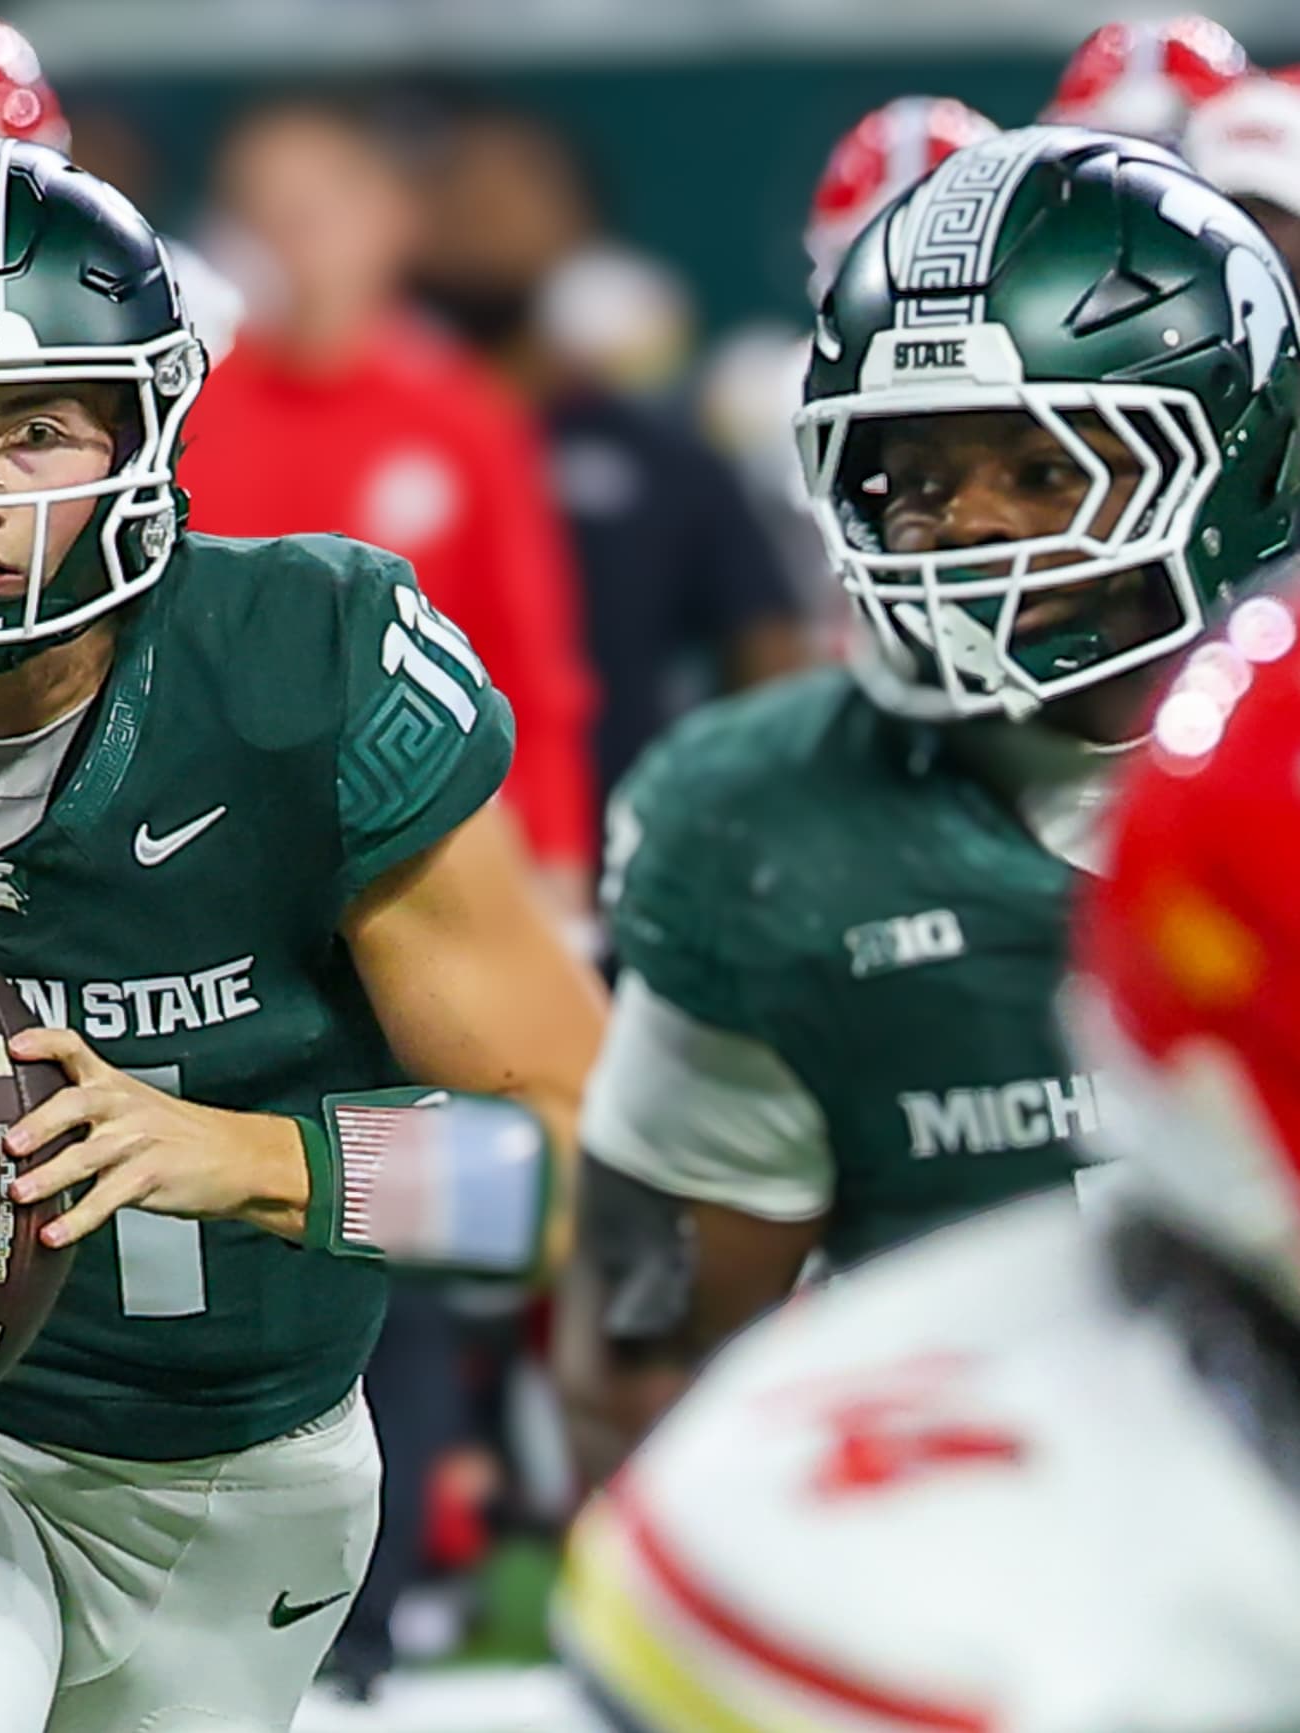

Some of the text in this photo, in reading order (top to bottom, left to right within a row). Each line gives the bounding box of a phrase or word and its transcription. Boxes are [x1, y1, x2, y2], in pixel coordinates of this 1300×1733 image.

[894, 339, 966, 369] STATE
[381, 584, 484, 735] 11
[83, 955, 260, 1039] STATE
[898, 1072, 1097, 1157] MICH
